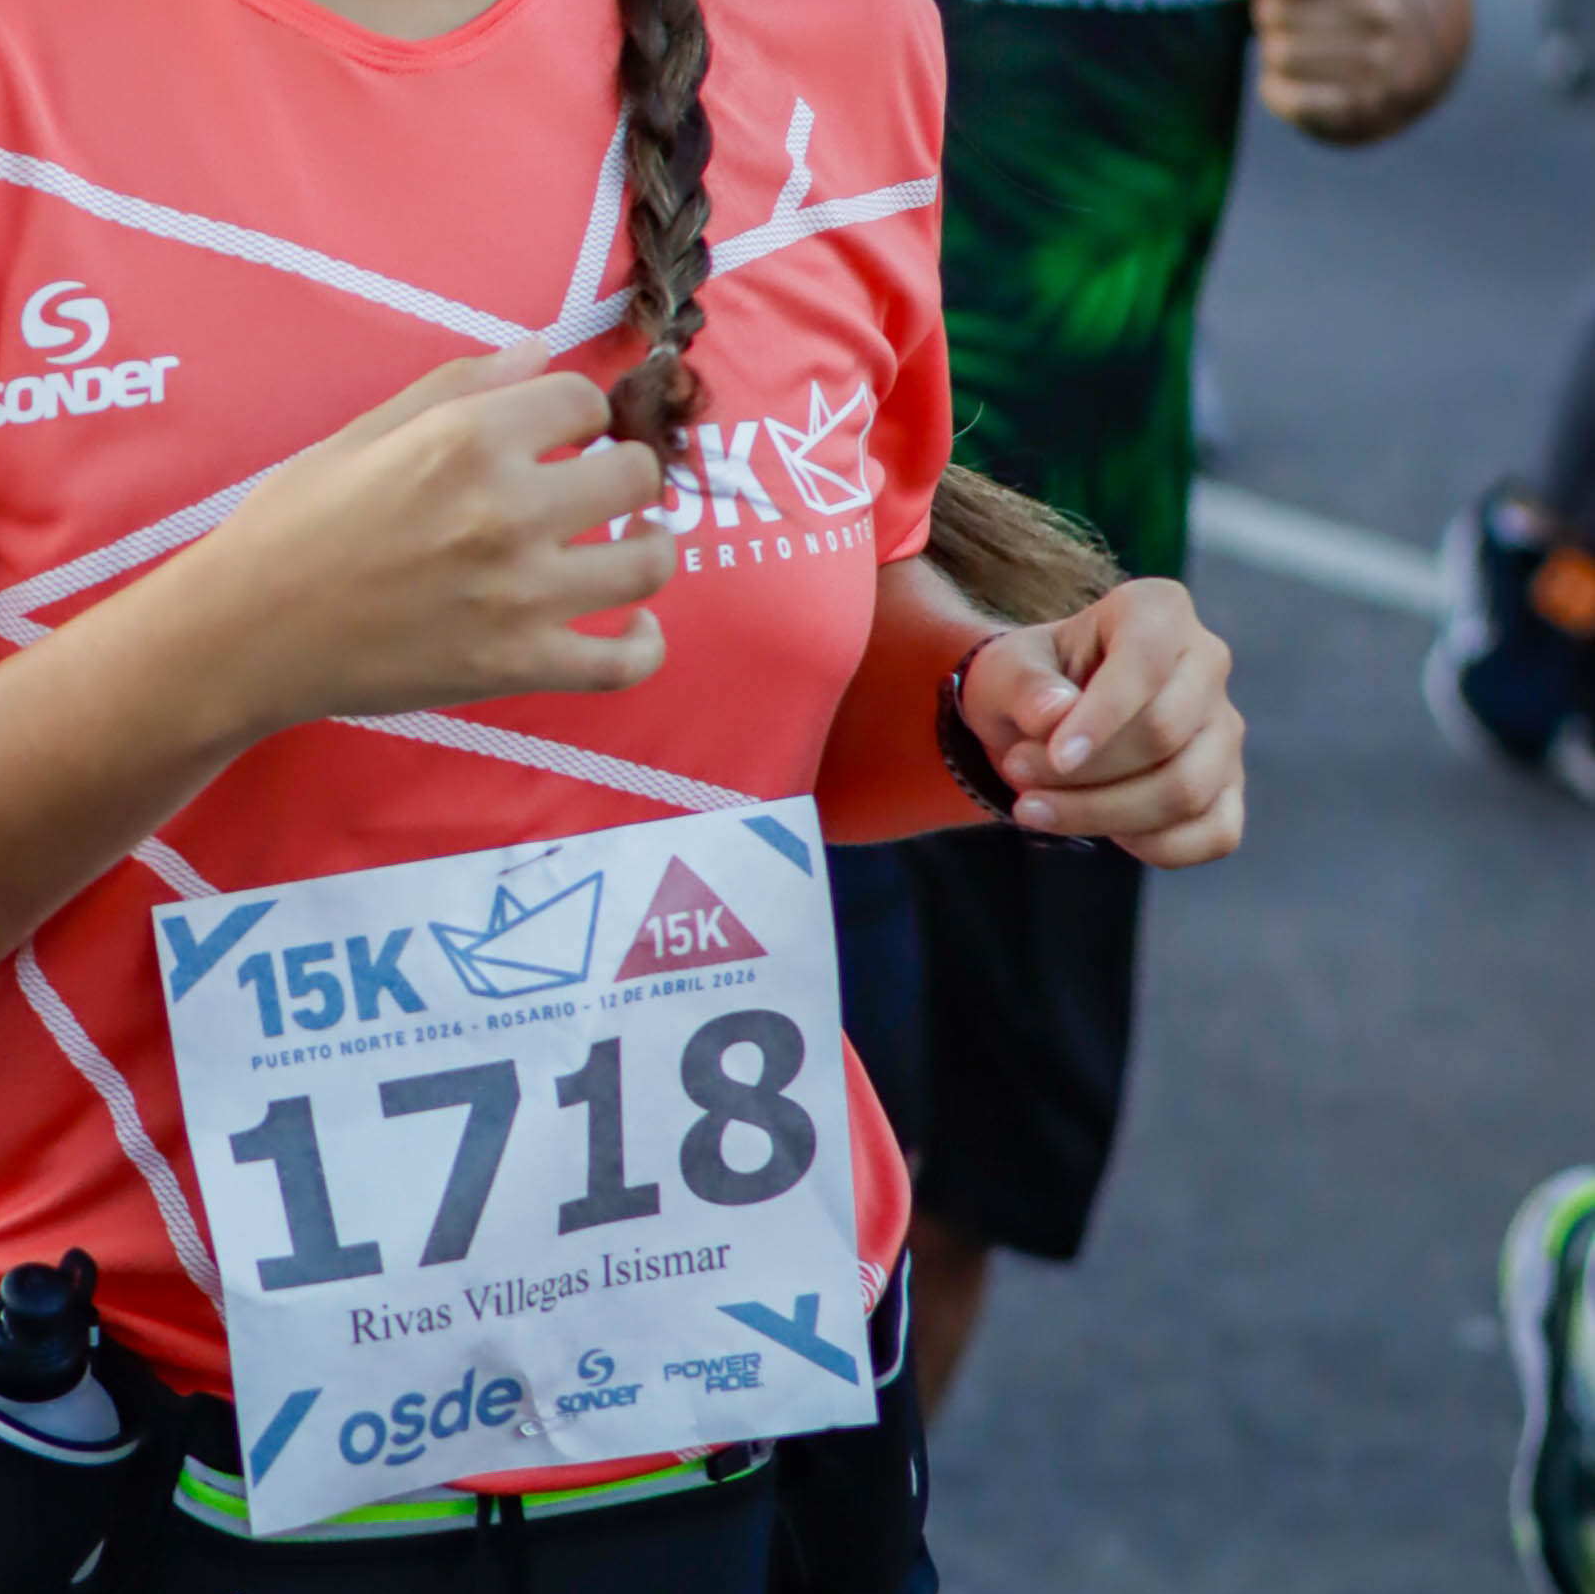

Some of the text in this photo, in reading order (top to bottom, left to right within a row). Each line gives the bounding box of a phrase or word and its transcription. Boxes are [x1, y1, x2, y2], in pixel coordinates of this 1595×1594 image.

[805, 518, 872, 555] NORTE
[237, 927, 429, 1038] 15K
[645, 904, 730, 959] 15K
[251, 1044, 333, 1071] PUERTO
[340, 1031, 407, 1056] NORTE
[414, 1019, 464, 1044] 2026
[486, 1001, 577, 1031] ROSARIO
[623, 985, 644, 1005] DE
[649, 976, 705, 999] ABRIL
[712, 967, 757, 989] 2026
[228, 1008, 817, 1293] 1718
[348, 1243, 732, 1345] Rivas Villegas Isismar
[339, 1365, 523, 1467] osde
[663, 1352, 762, 1382] POWER
